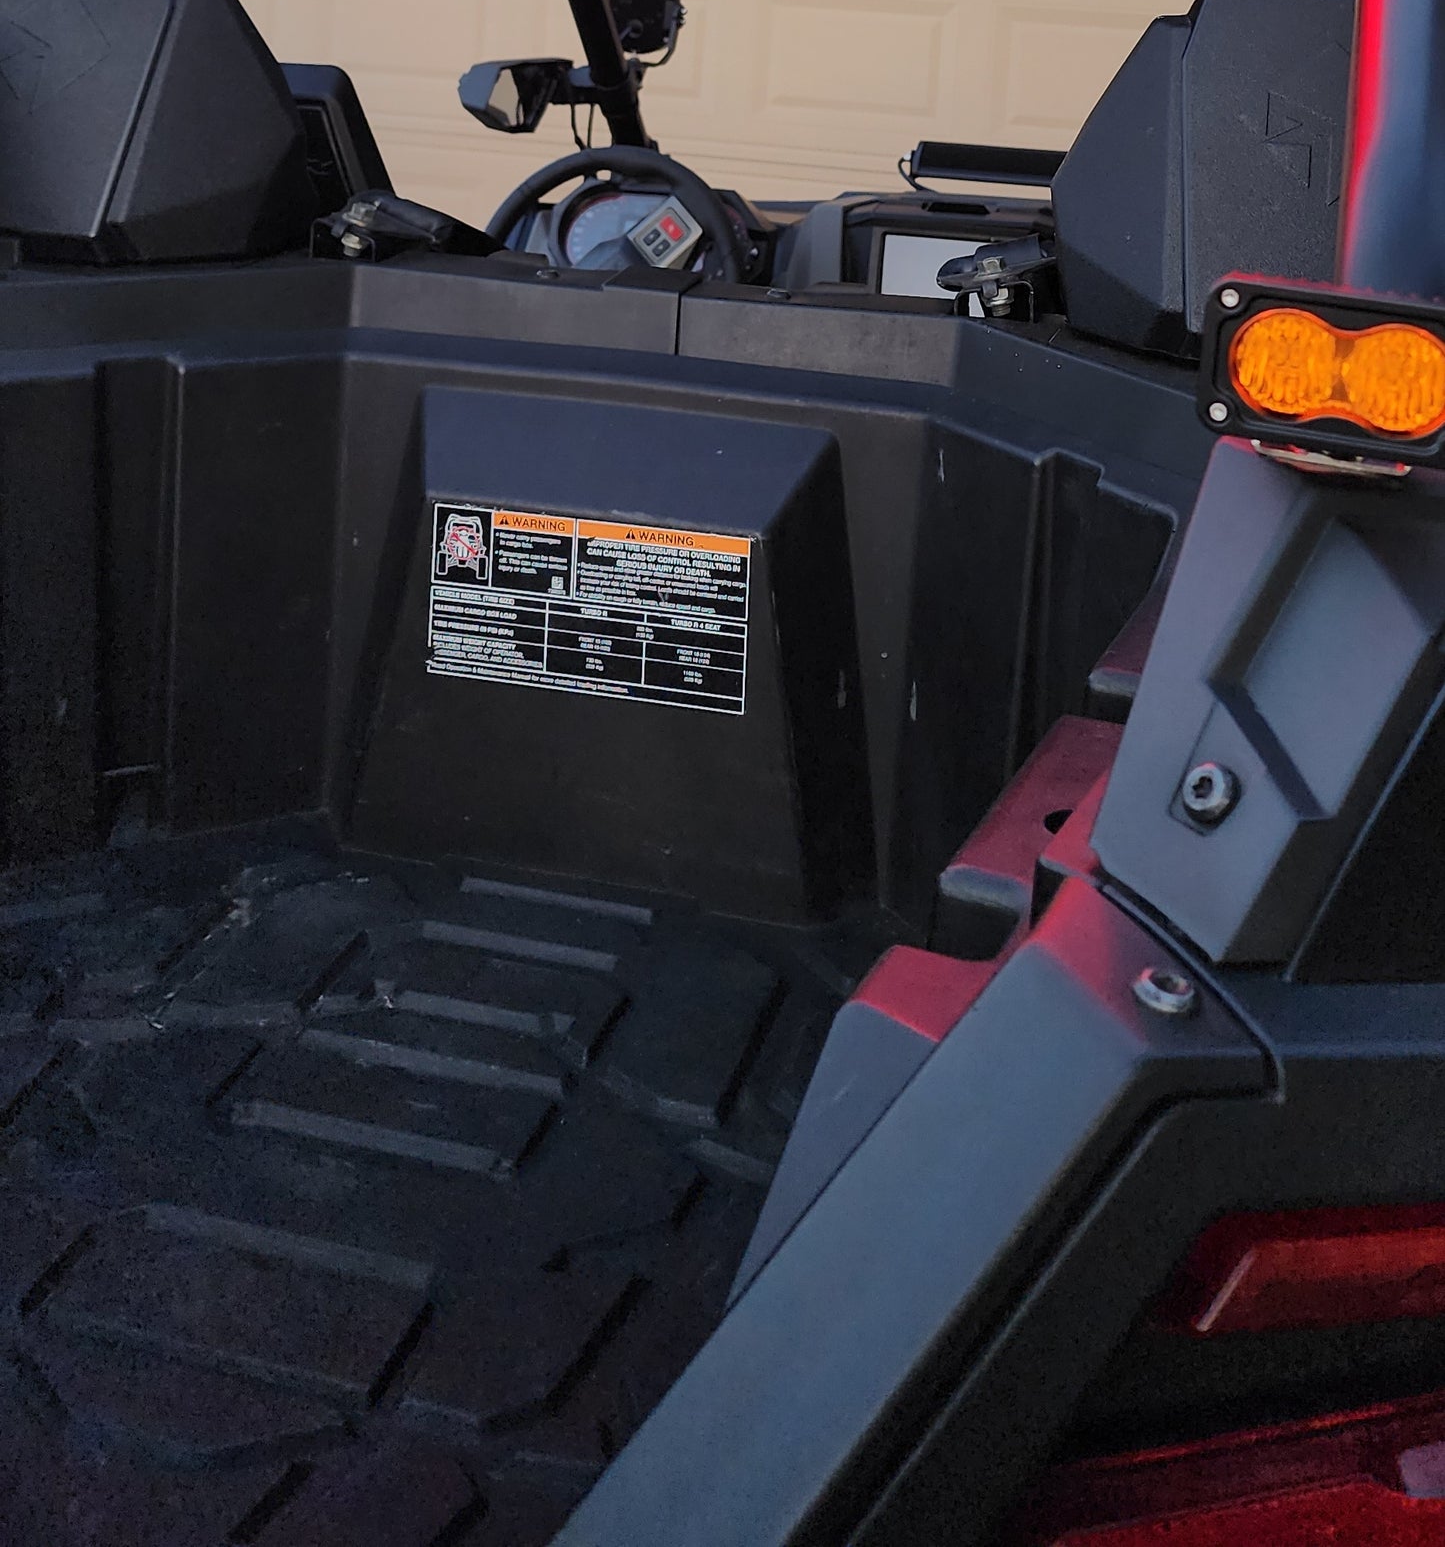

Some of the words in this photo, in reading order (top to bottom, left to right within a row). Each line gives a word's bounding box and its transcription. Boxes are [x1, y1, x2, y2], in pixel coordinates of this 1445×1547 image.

[512, 516, 566, 532] WARNING
[639, 530, 694, 546] WARNING
[587, 548, 602, 556] CAN
[658, 556, 691, 567] CONTROL
[692, 560, 732, 571] RESULTING
[691, 551, 740, 564] OVERLOADING
